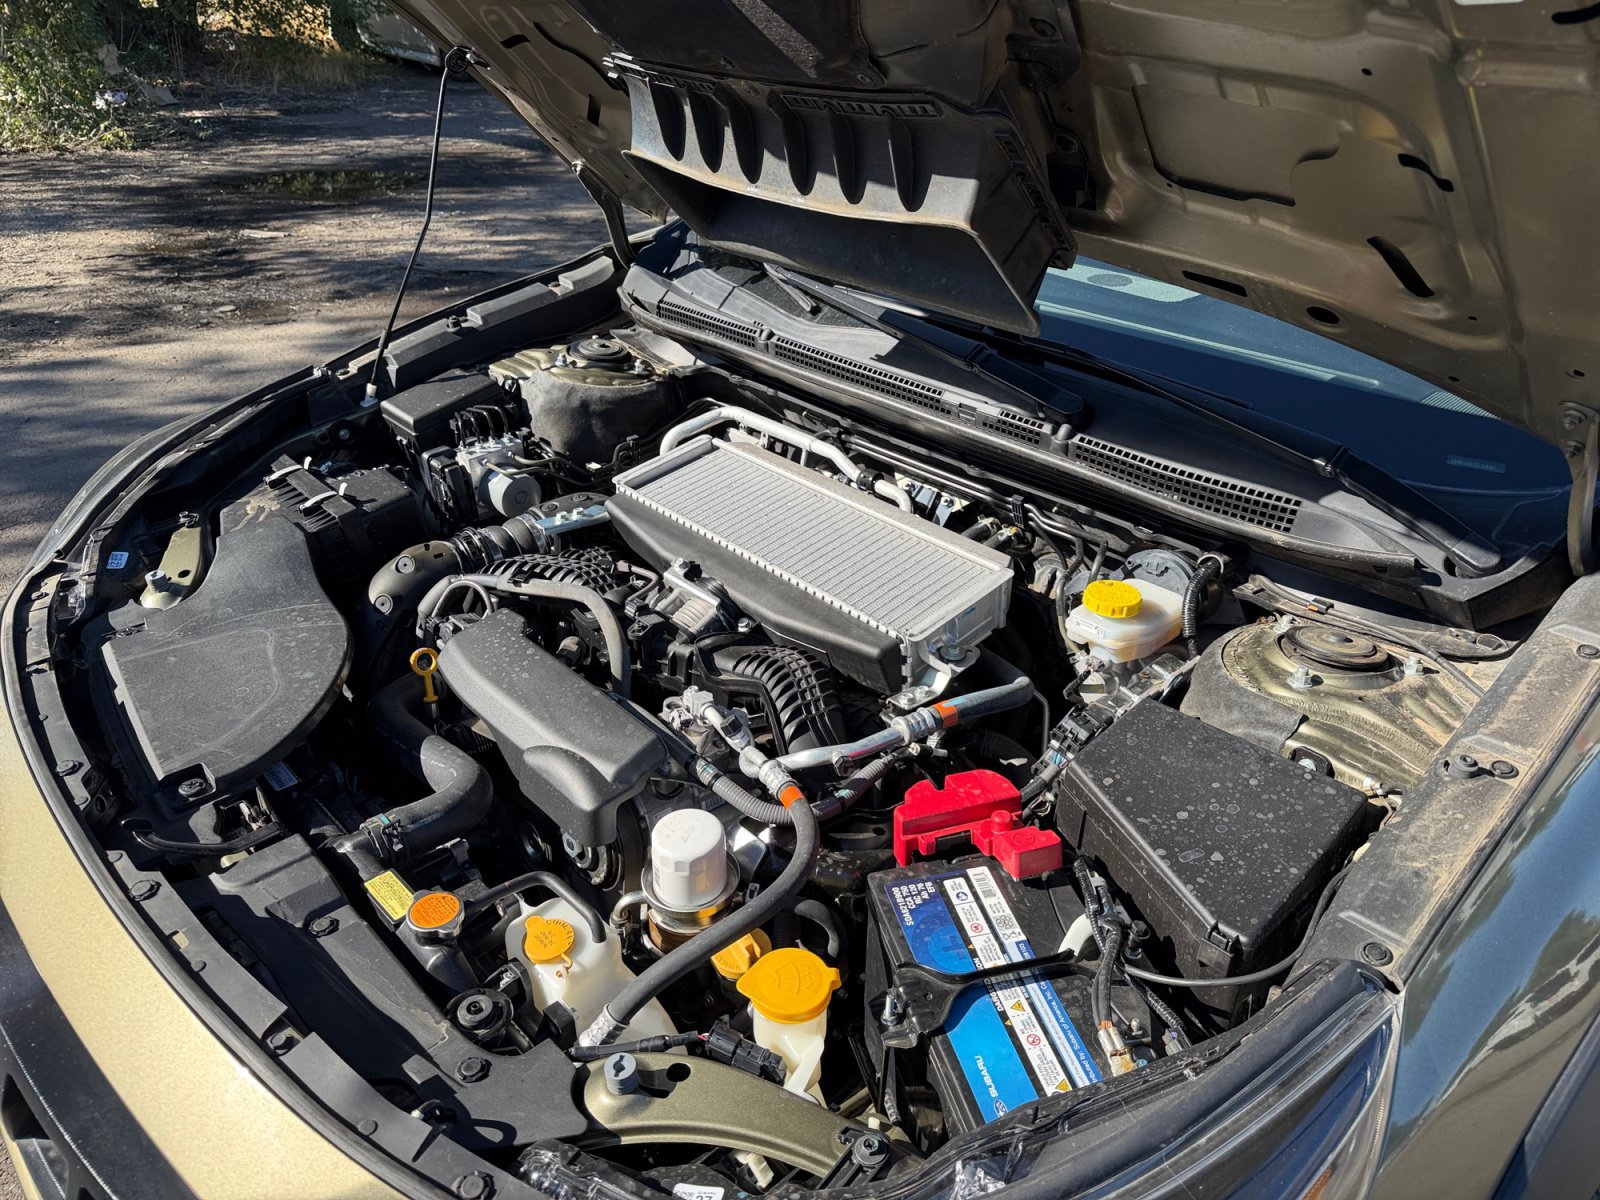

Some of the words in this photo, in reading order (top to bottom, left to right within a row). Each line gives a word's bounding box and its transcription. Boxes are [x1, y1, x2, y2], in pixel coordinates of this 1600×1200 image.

[900, 886, 911, 897] 750
[908, 884, 919, 895] 120
[924, 882, 936, 893] EFB
[905, 897, 916, 909] CCA
[913, 895, 923, 905] RC
[1066, 1030, 1080, 1050] Subaru
[974, 1056, 998, 1097] SUBARU
